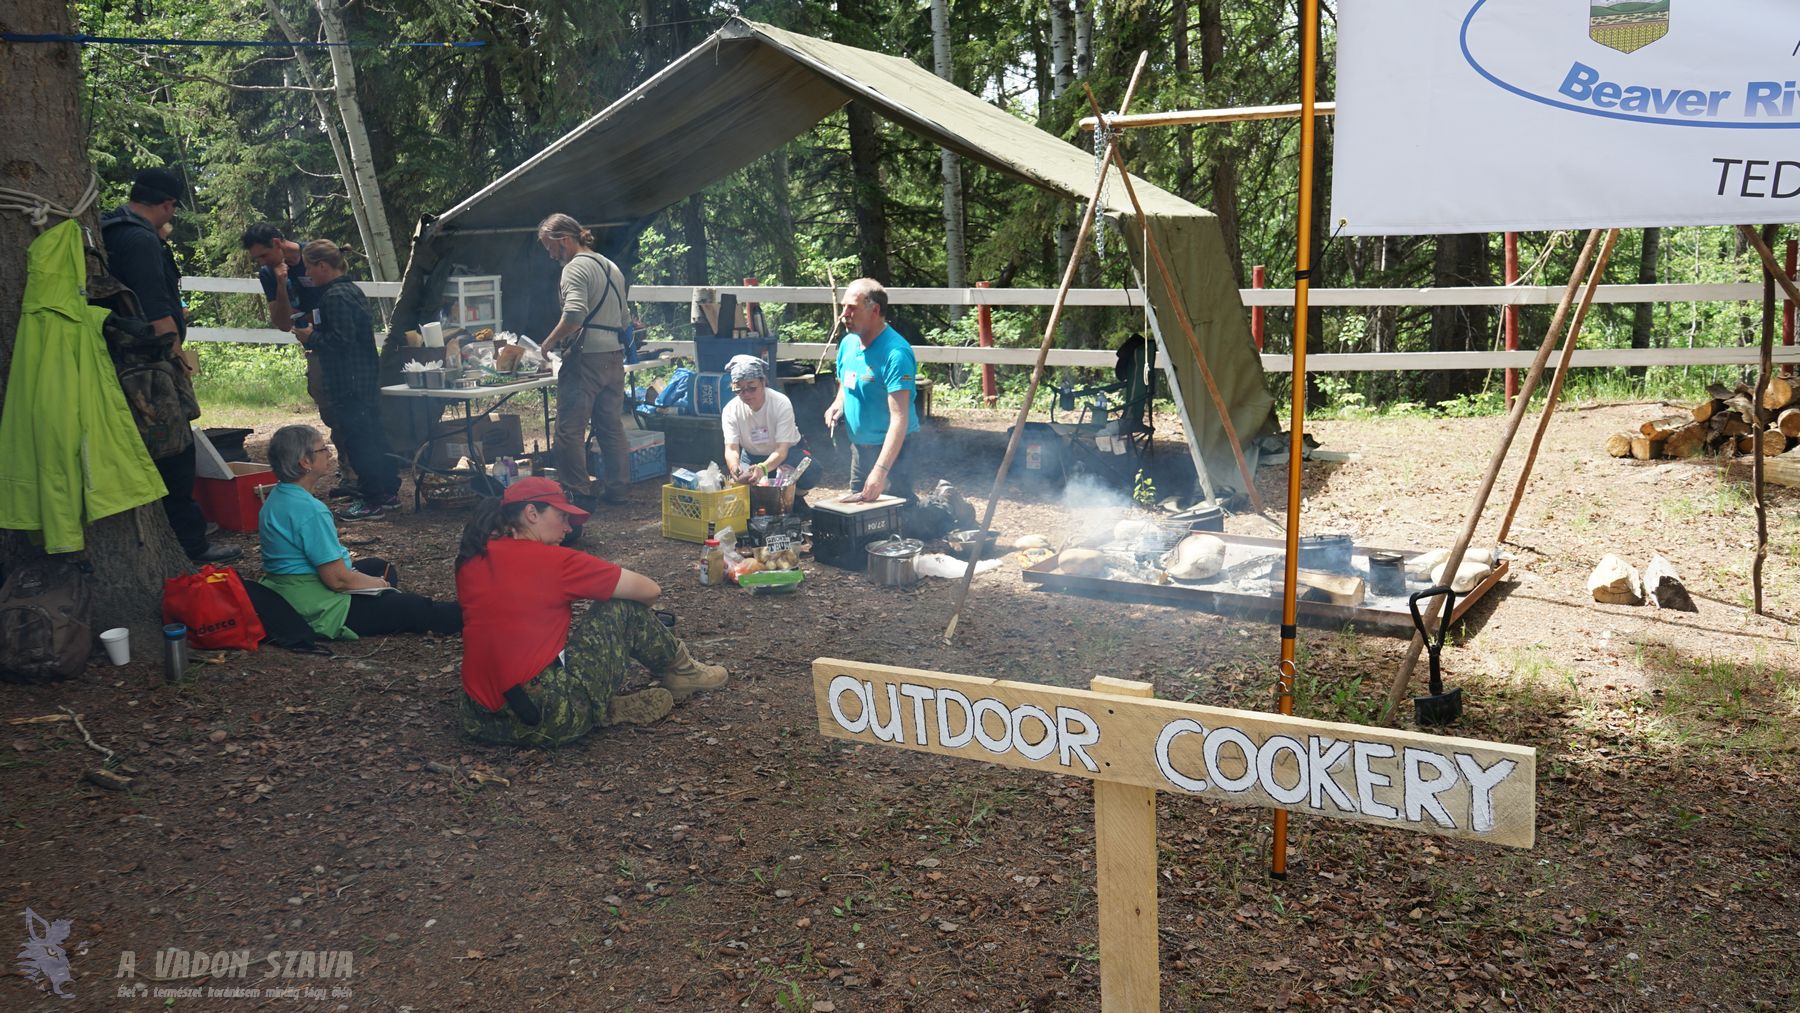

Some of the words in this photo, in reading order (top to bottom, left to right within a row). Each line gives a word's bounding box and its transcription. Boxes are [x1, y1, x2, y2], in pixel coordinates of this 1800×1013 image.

[1558, 61, 1731, 116] Beaver
[1743, 81, 1800, 118] Ri
[828, 674, 1101, 773] OUTDOOR
[1154, 718, 1518, 832] COOKERY
